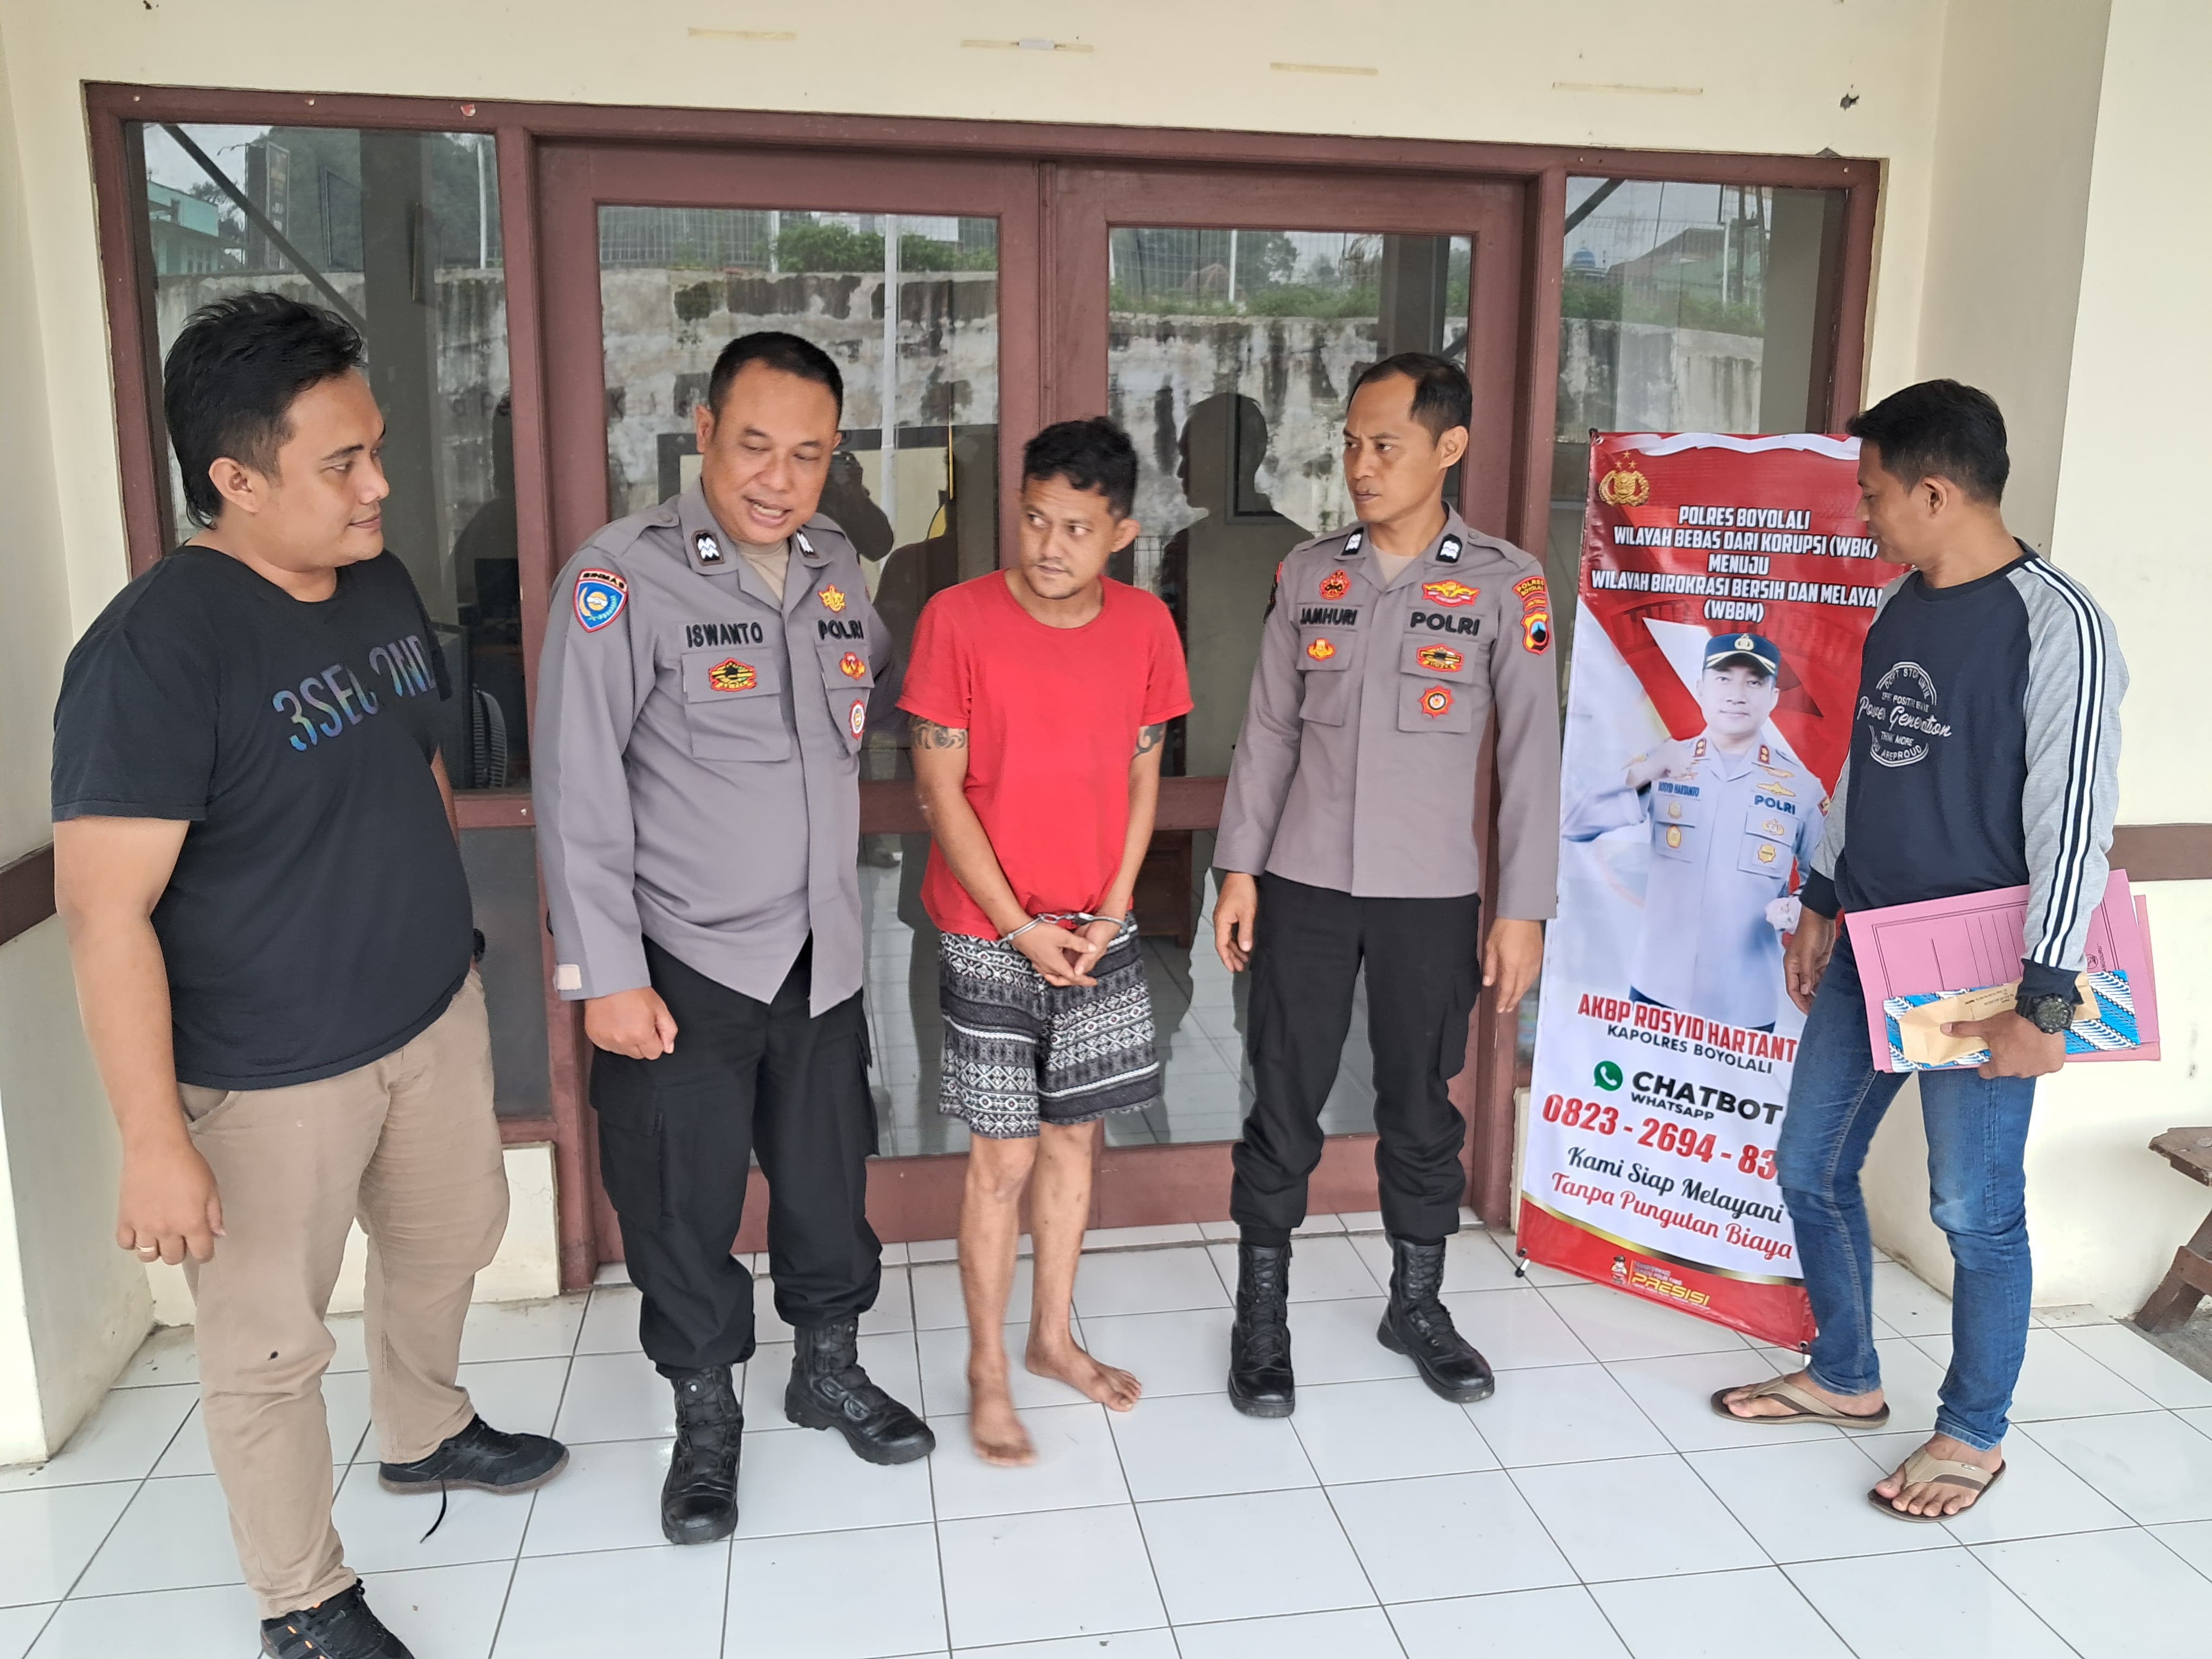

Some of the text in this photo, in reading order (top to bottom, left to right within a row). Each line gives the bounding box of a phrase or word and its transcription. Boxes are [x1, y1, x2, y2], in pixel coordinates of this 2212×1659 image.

[1678, 506, 1810, 530] POLRES BOYOLALI
[1613, 526, 1878, 559] WILAYAH BEBAS DARI KORUPSI (WBK)
[1708, 554, 1770, 575] MENUJU
[1516, 579, 1545, 592] POLRES
[1592, 571, 1649, 591] WILAYAH
[1651, 573, 1730, 596] BIROKRASI
[1732, 578, 1784, 600] BERSIH
[1787, 581, 1819, 602] DAN
[1410, 612, 1481, 636] POLRI
[1703, 600, 1765, 623] (WBBM)
[686, 622, 764, 648] ISWANTO
[818, 620, 864, 640] POLRI
[1754, 794, 1796, 815] POLRI
[2097, 946, 2106, 972] ANGGURU
[1578, 994, 1798, 1063] AKBP ROSYID HARTANT
[1607, 1025, 1773, 1074] KAPOLRES BOYOLALI
[1631, 1092, 1714, 1121] WHATSAPP
[1632, 1071, 1784, 1125] CHATBOT
[1542, 1094, 1619, 1135] 0823
[1637, 1117, 1716, 1162] 2694
[1568, 1147, 1784, 1224] Kami Siap Melayani
[1552, 1172, 1793, 1260] Tanpa Pungutan Biaya
[1631, 1272, 1711, 1306] PRESISI
